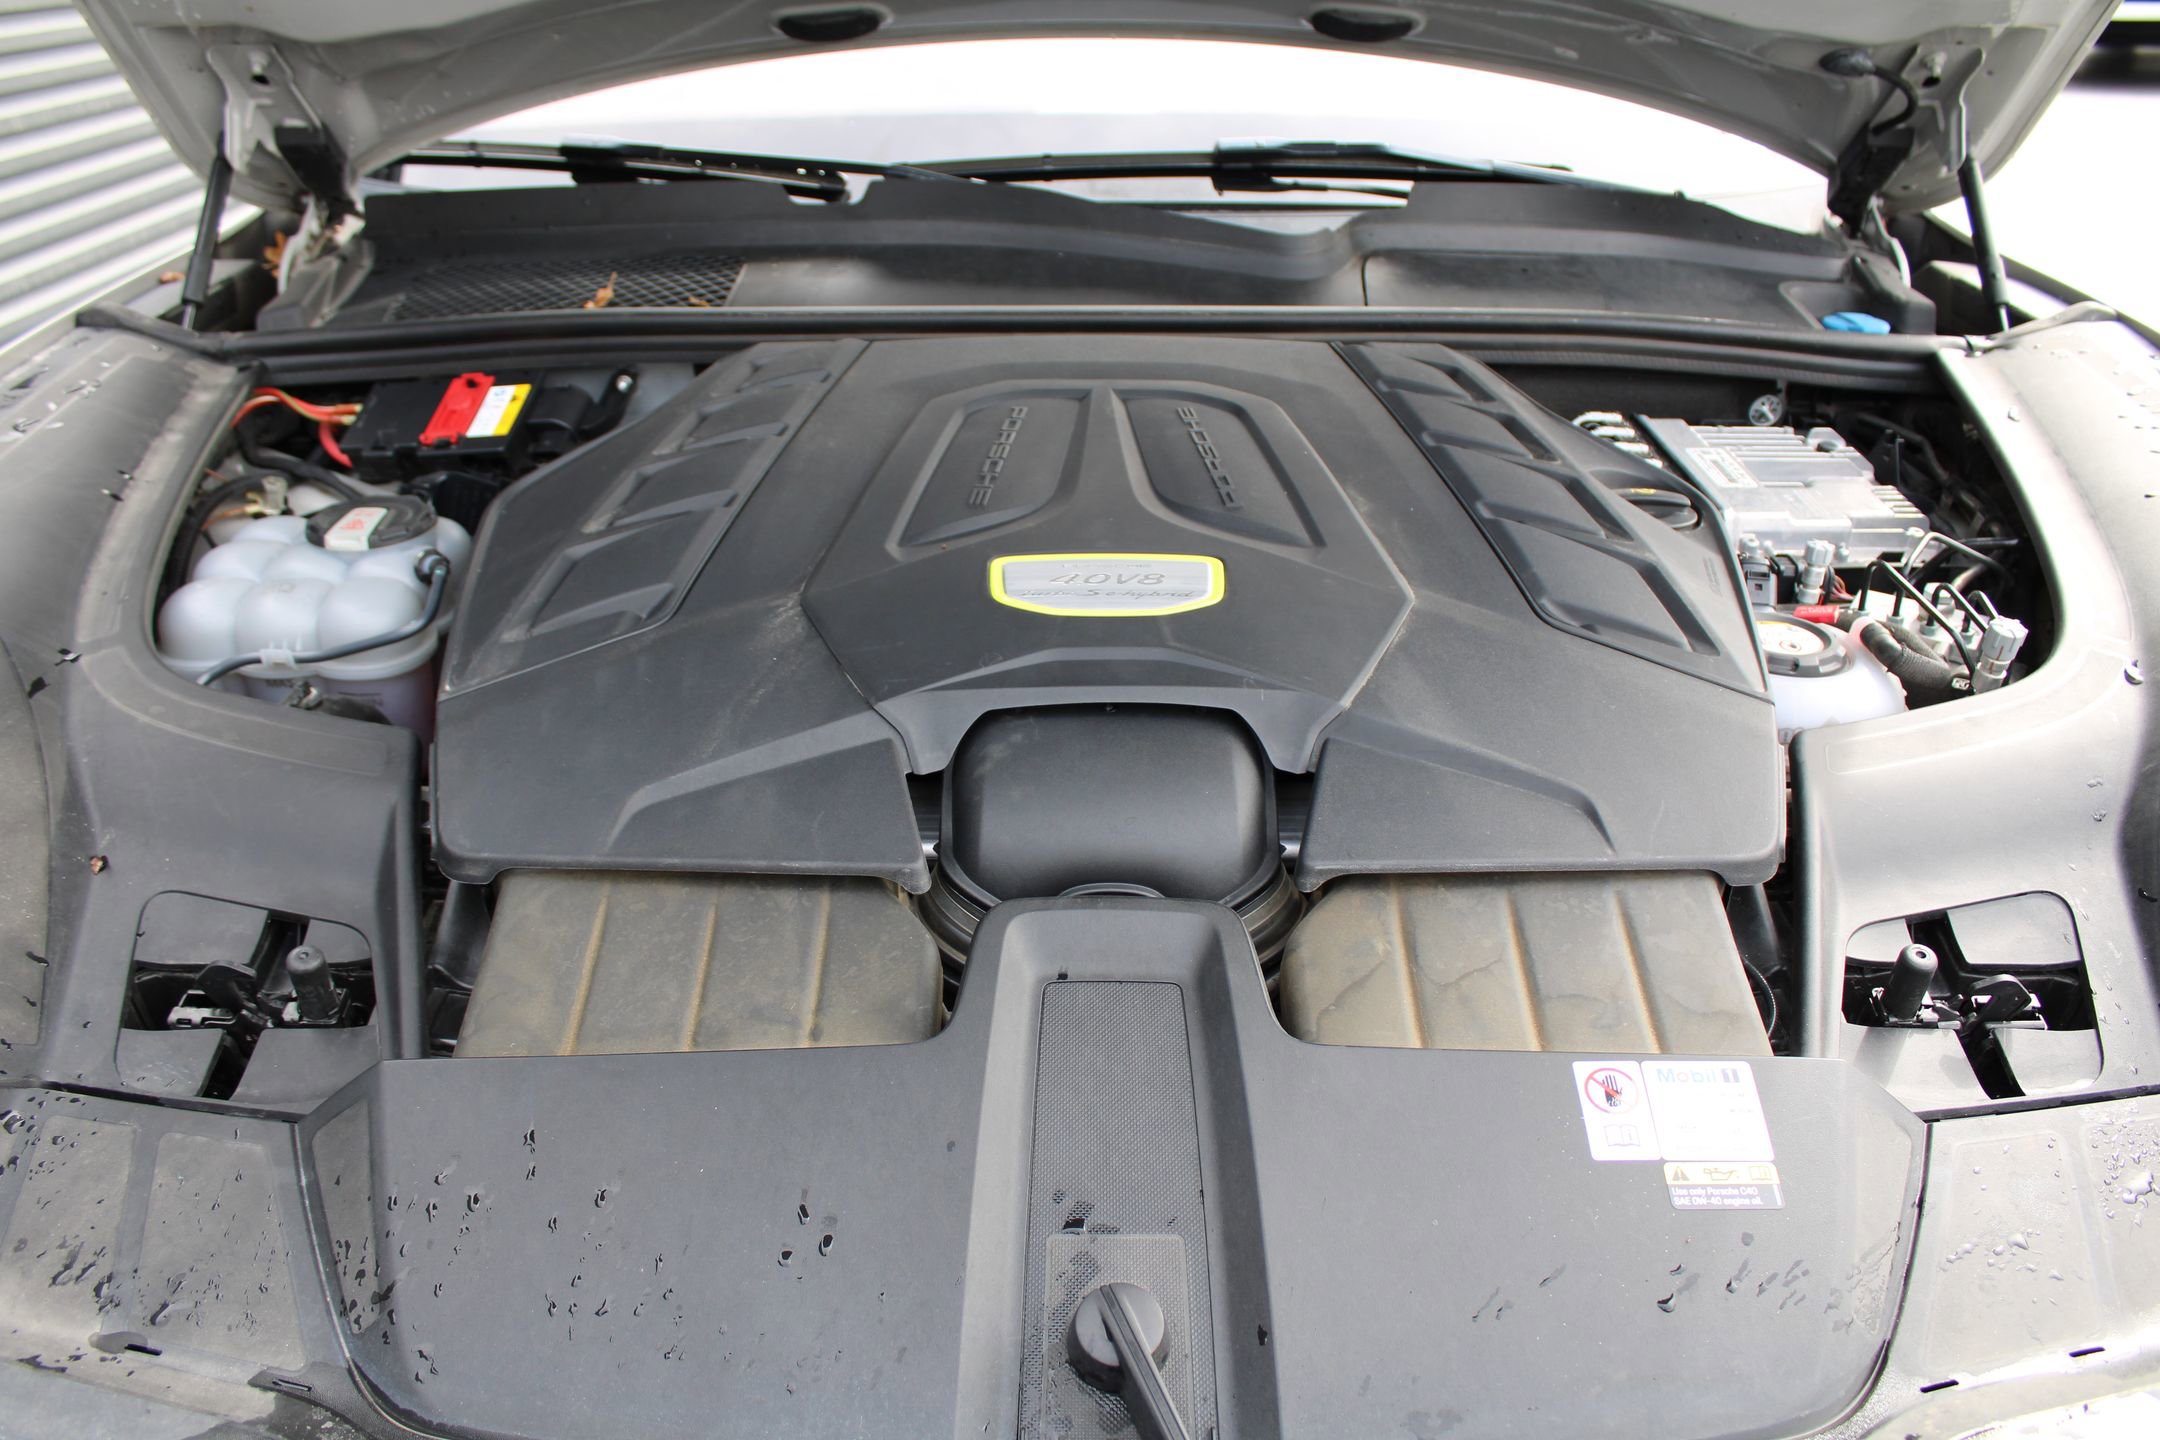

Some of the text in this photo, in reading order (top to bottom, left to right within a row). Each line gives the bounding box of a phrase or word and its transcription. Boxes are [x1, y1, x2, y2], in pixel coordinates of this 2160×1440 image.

[969, 406, 1028, 505] PORSCHE
[1176, 407, 1239, 508] PORSCHE
[1656, 1068, 1717, 1083] Mobil
[1707, 1187, 1739, 1196] Porsche
